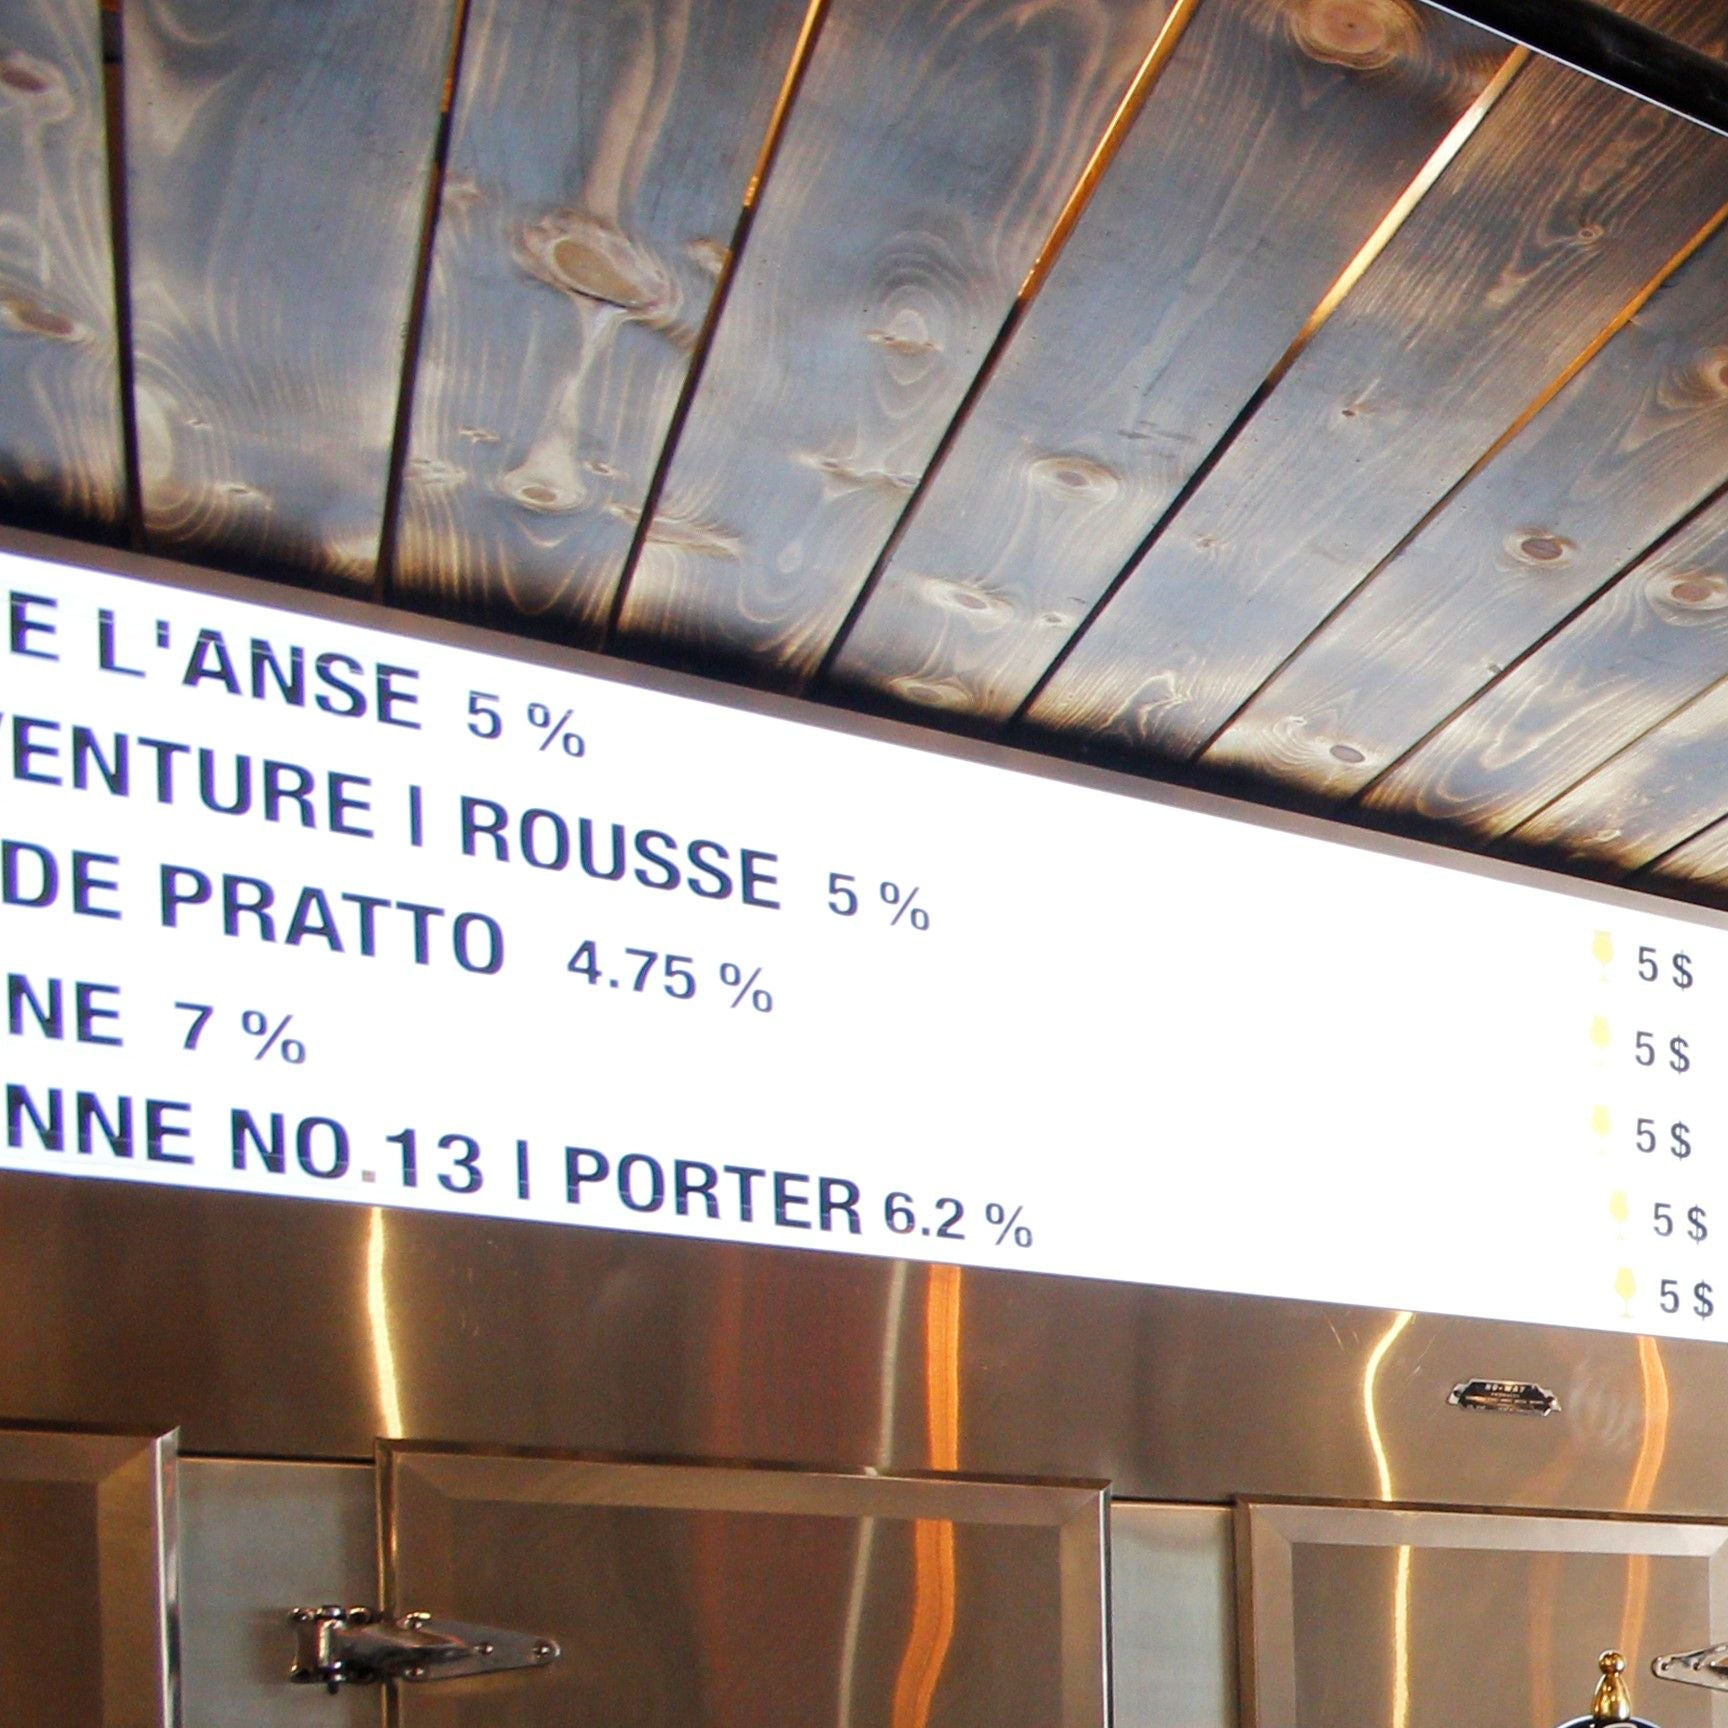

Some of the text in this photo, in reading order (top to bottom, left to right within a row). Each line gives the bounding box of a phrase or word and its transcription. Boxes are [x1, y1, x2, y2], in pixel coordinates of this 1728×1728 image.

[7, 589, 60, 662] E
[97, 607, 422, 731] L'ANSE
[467, 689, 503, 740] 5
[0, 711, 375, 839] ENTURE
[459, 794, 781, 911] ROUSSE
[827, 871, 859, 917] 5
[1, 838, 123, 921] DE
[159, 862, 505, 976] PRATTO
[566, 939, 697, 1000] 4.75
[1638, 945, 1659, 982] 5
[6, 971, 124, 1048] NE
[173, 1000, 214, 1051] 7
[1635, 1030, 1656, 1067] 5
[4, 1082, 195, 1166] NNE
[564, 1145, 862, 1235] PORTER
[883, 1191, 966, 1241] 6.2
[1636, 1117, 1657, 1154] 5
[1653, 1202, 1674, 1237] 5
[1660, 1278, 1680, 1314] 5
